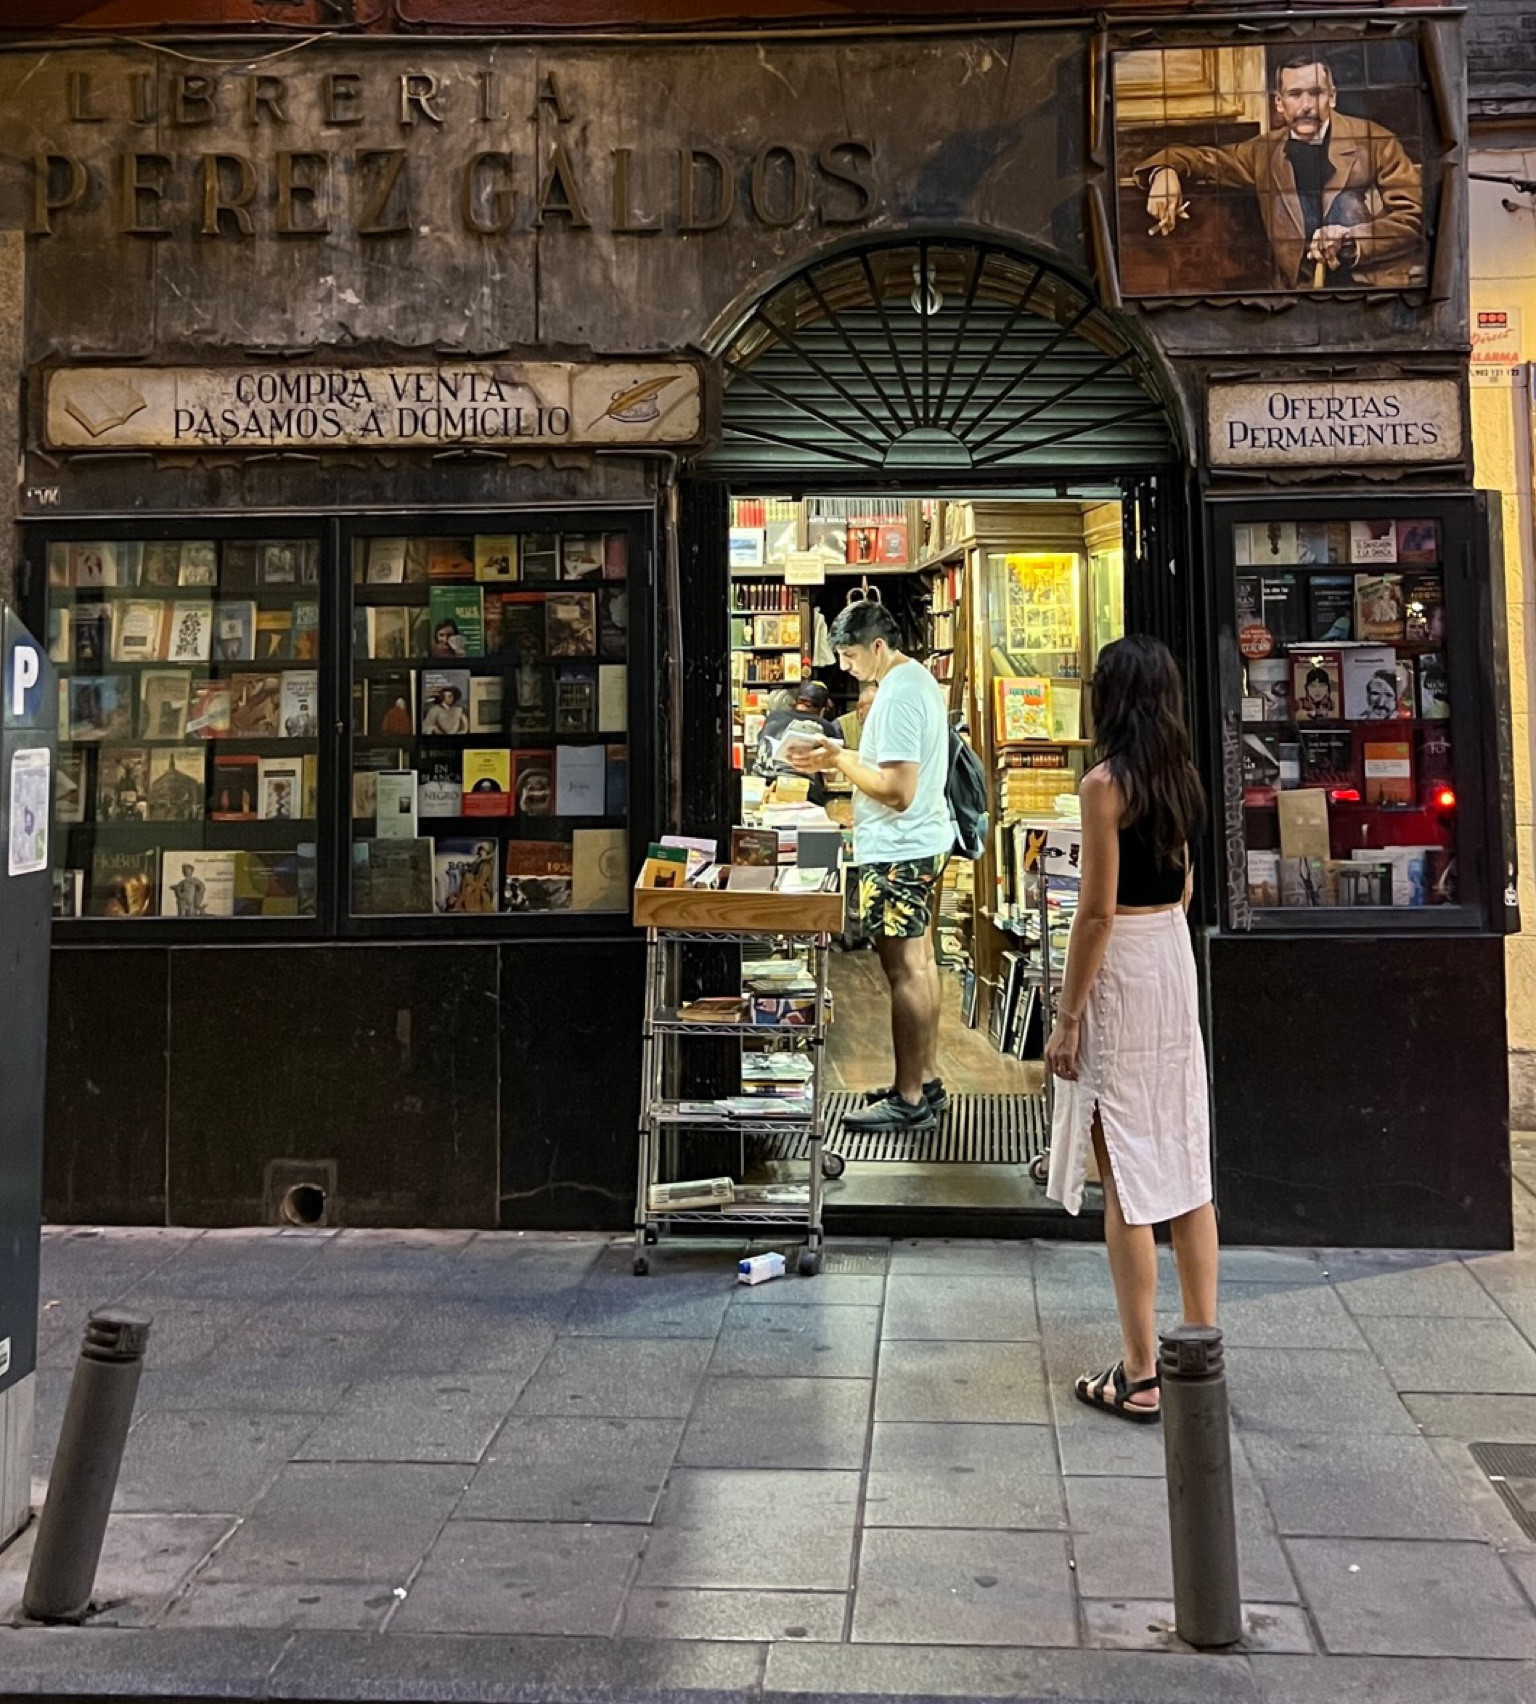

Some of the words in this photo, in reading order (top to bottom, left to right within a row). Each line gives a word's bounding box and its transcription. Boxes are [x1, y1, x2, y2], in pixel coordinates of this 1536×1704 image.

[69, 71, 575, 126] LIBRERIA
[29, 148, 412, 236] PEREZ
[460, 140, 878, 236] GALDOS
[236, 372, 374, 411] COMPRA
[392, 370, 507, 404] VENTA
[1268, 392, 1401, 421] OFERTAS
[173, 408, 344, 440] PASAMOS
[359, 408, 386, 438] A
[398, 405, 571, 441] DOMICILIO
[1228, 421, 1439, 451] PERMANENTES
[13, 645, 39, 715] P
